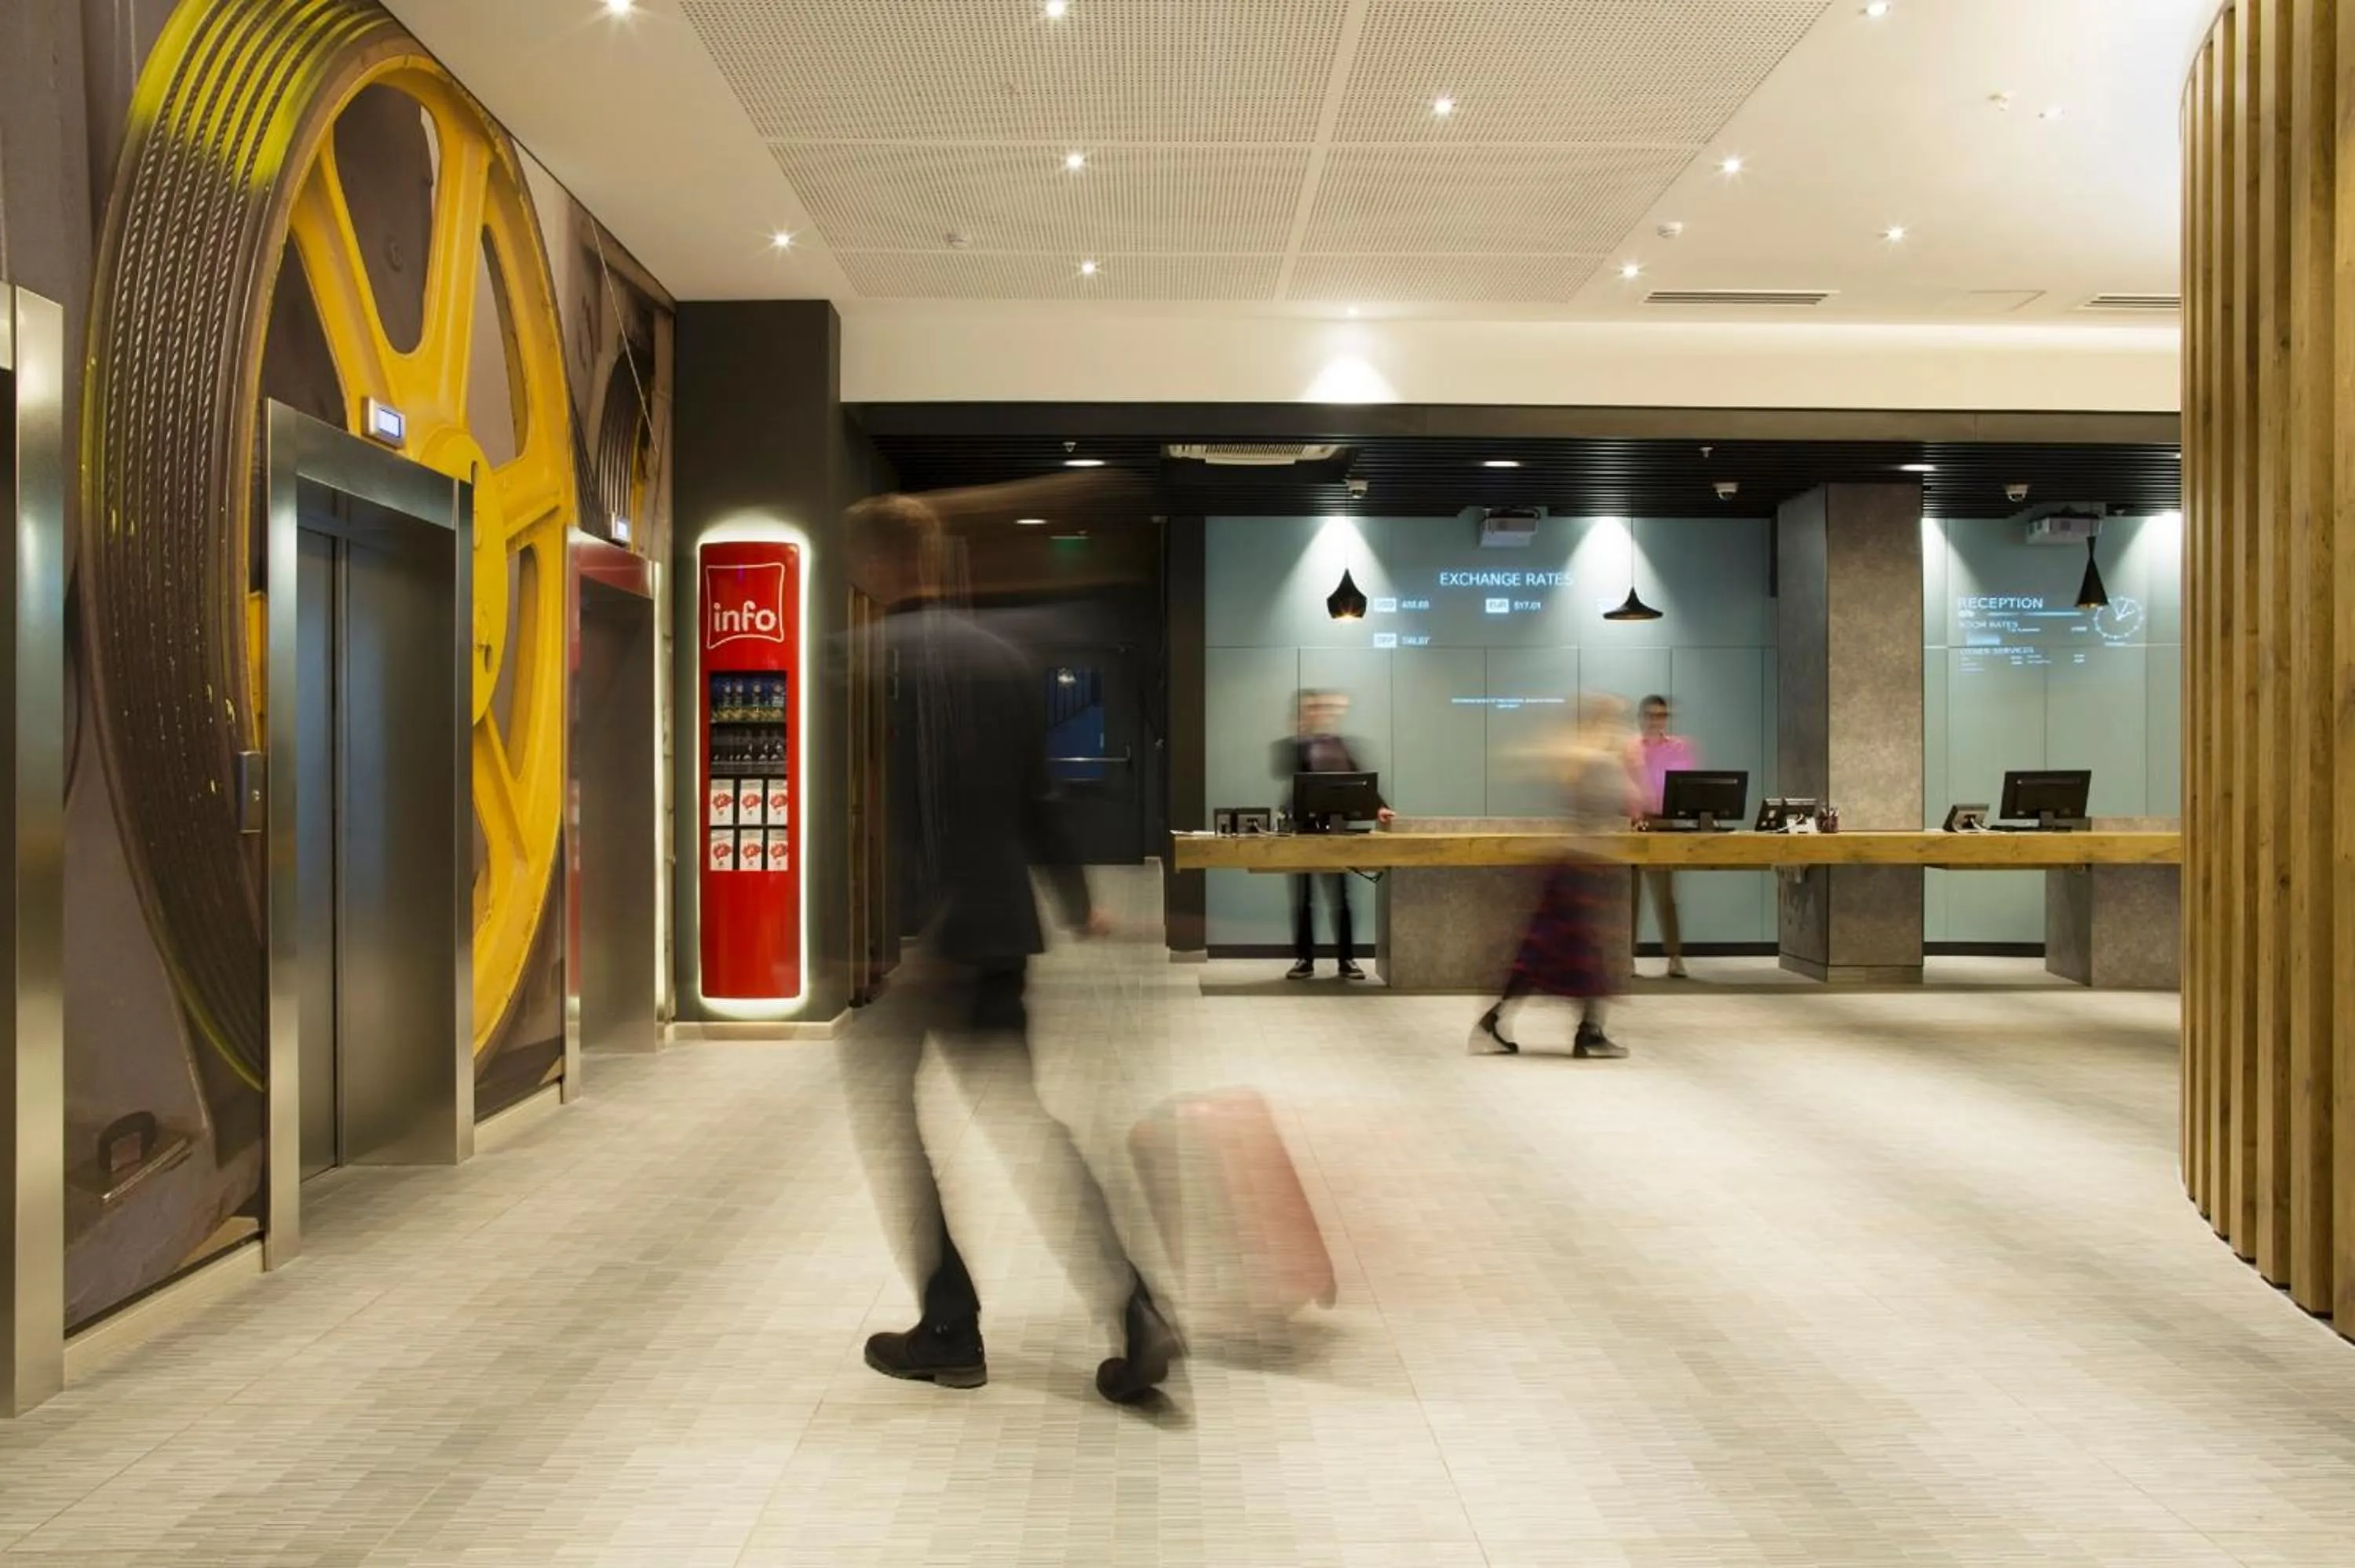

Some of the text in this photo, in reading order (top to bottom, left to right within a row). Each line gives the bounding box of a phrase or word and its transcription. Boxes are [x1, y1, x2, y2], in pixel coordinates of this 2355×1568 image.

[1439, 571, 1574, 586] EXCHANGE RATES
[1958, 596, 2044, 609] RECEPTION
[713, 600, 777, 633] info
